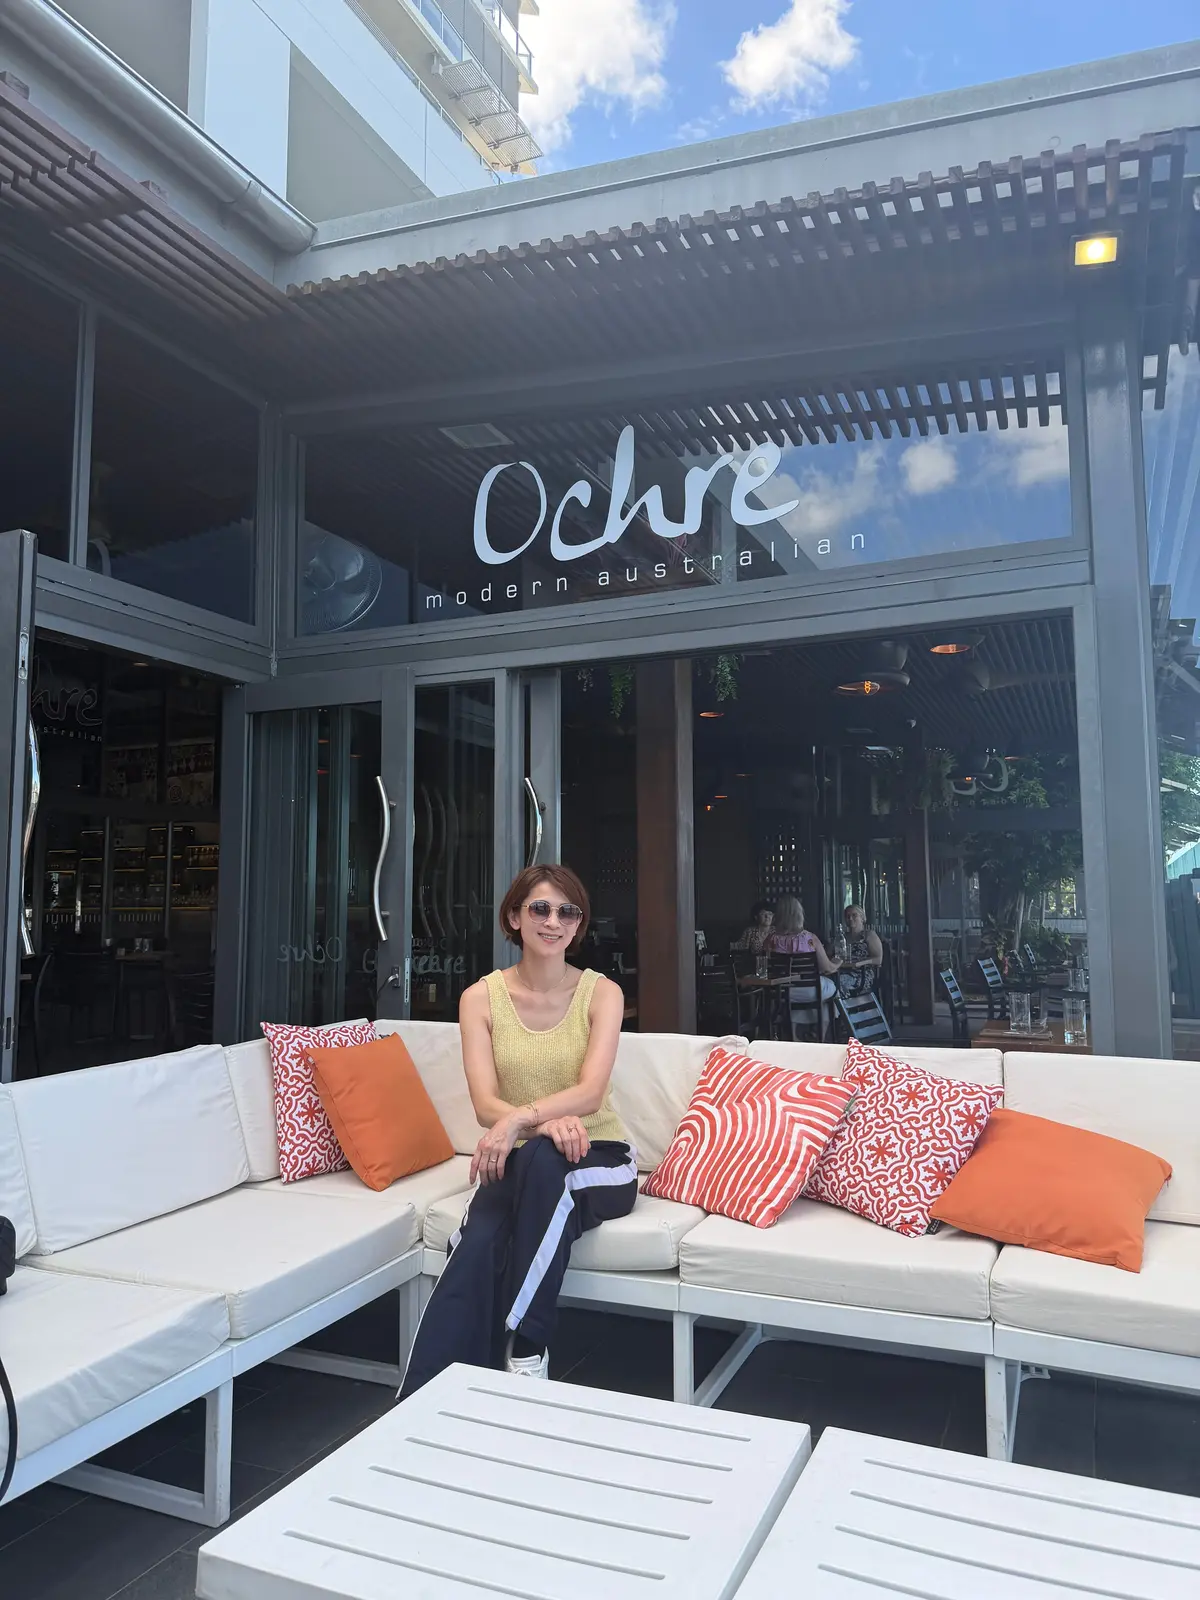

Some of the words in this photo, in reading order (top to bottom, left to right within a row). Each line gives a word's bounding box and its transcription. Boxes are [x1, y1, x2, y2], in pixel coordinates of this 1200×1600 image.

[473, 425, 799, 565] Ochre
[426, 577, 568, 608] modern
[598, 533, 866, 585] australian
